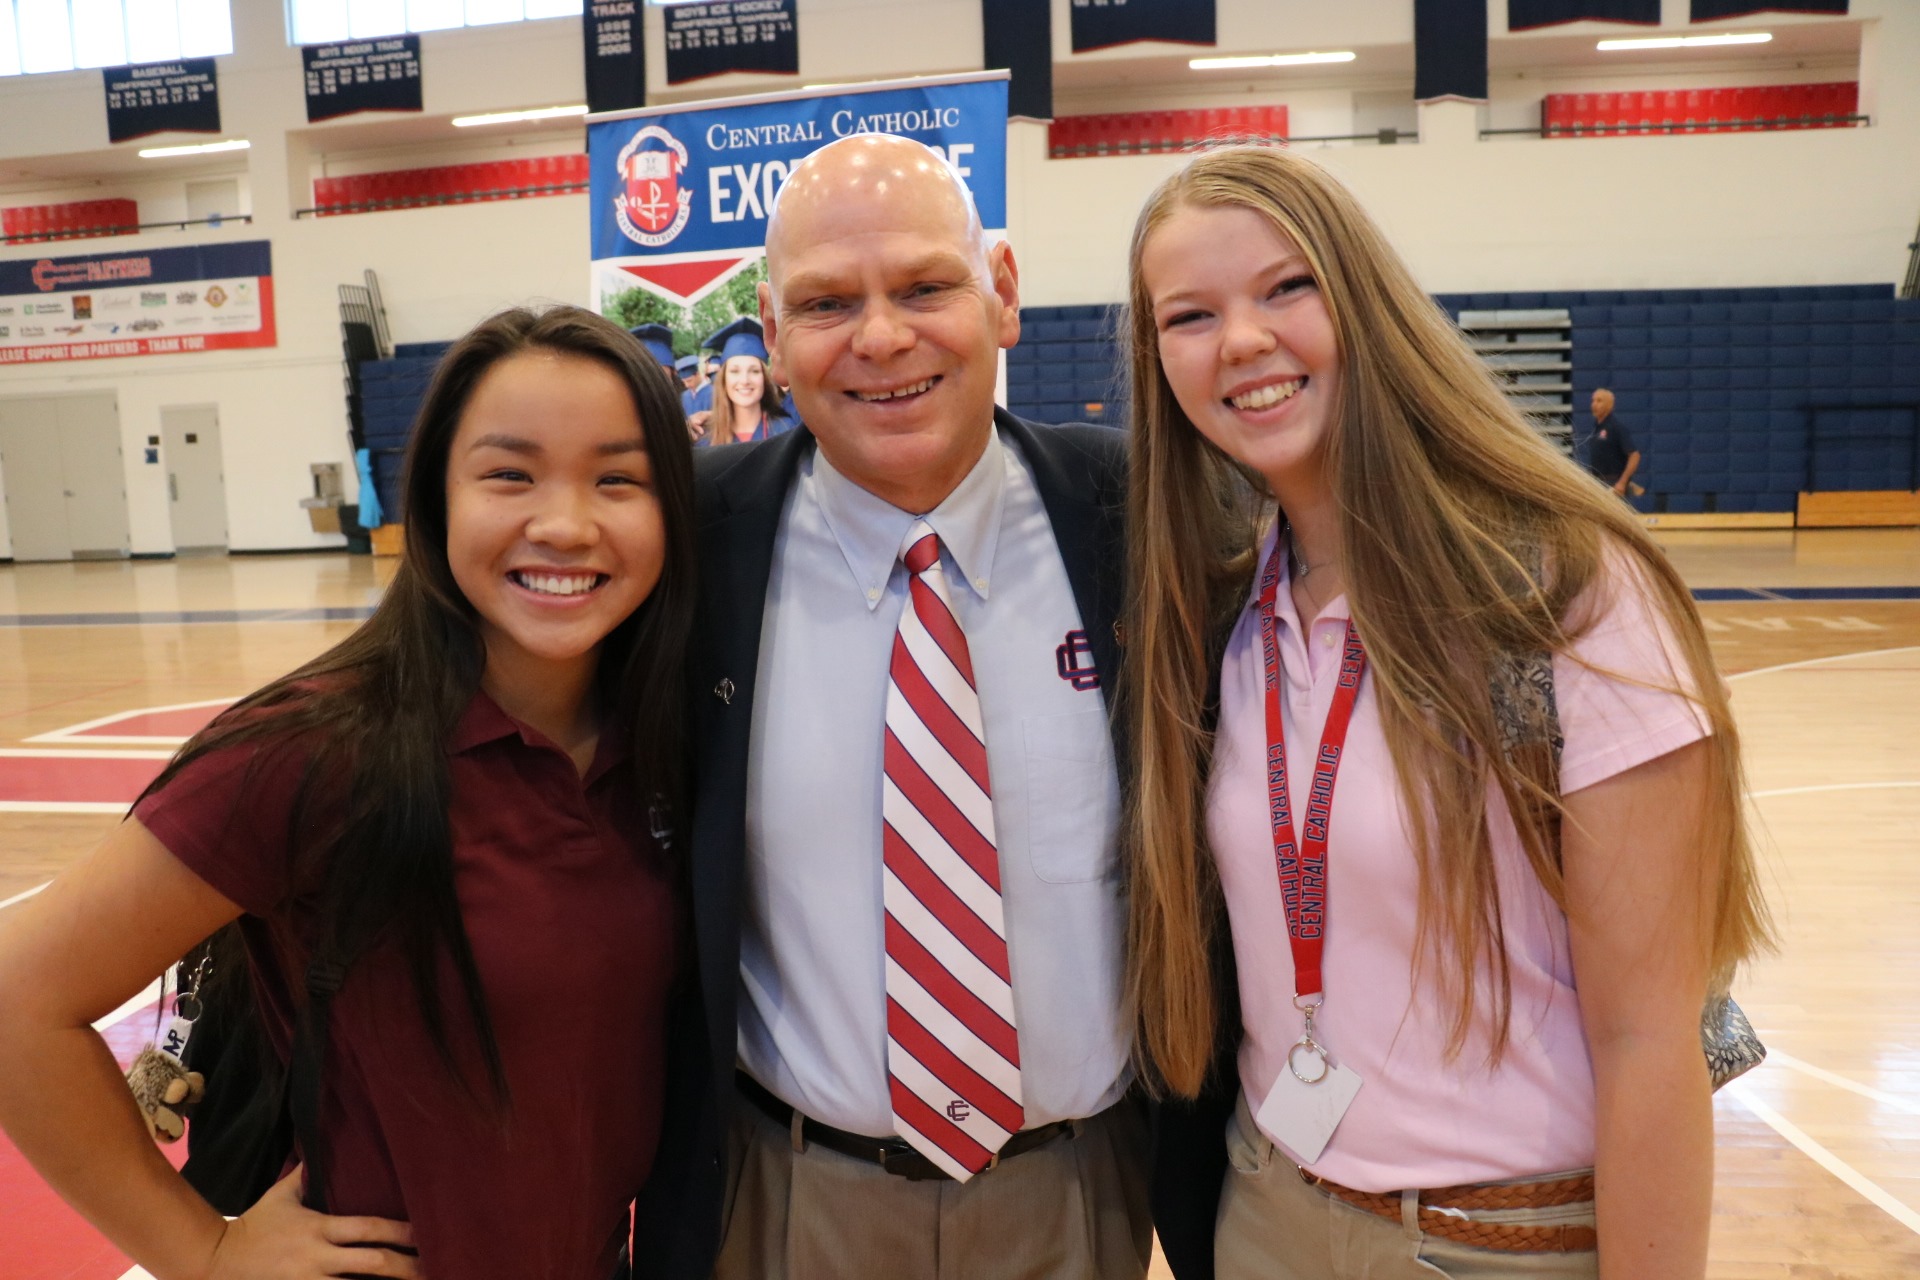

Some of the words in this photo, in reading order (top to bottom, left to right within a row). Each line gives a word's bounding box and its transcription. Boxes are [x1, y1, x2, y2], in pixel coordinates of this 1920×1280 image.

[591, 2, 635, 18] TRACK
[132, 65, 186, 79] BASEBALL
[706, 121, 823, 151] CENTRAL
[831, 107, 960, 138] CATHOLIC
[1267, 743, 1291, 834] CENTRAL
[1305, 744, 1340, 842] CATHOLIC
[1299, 852, 1326, 940] CENTRAL
